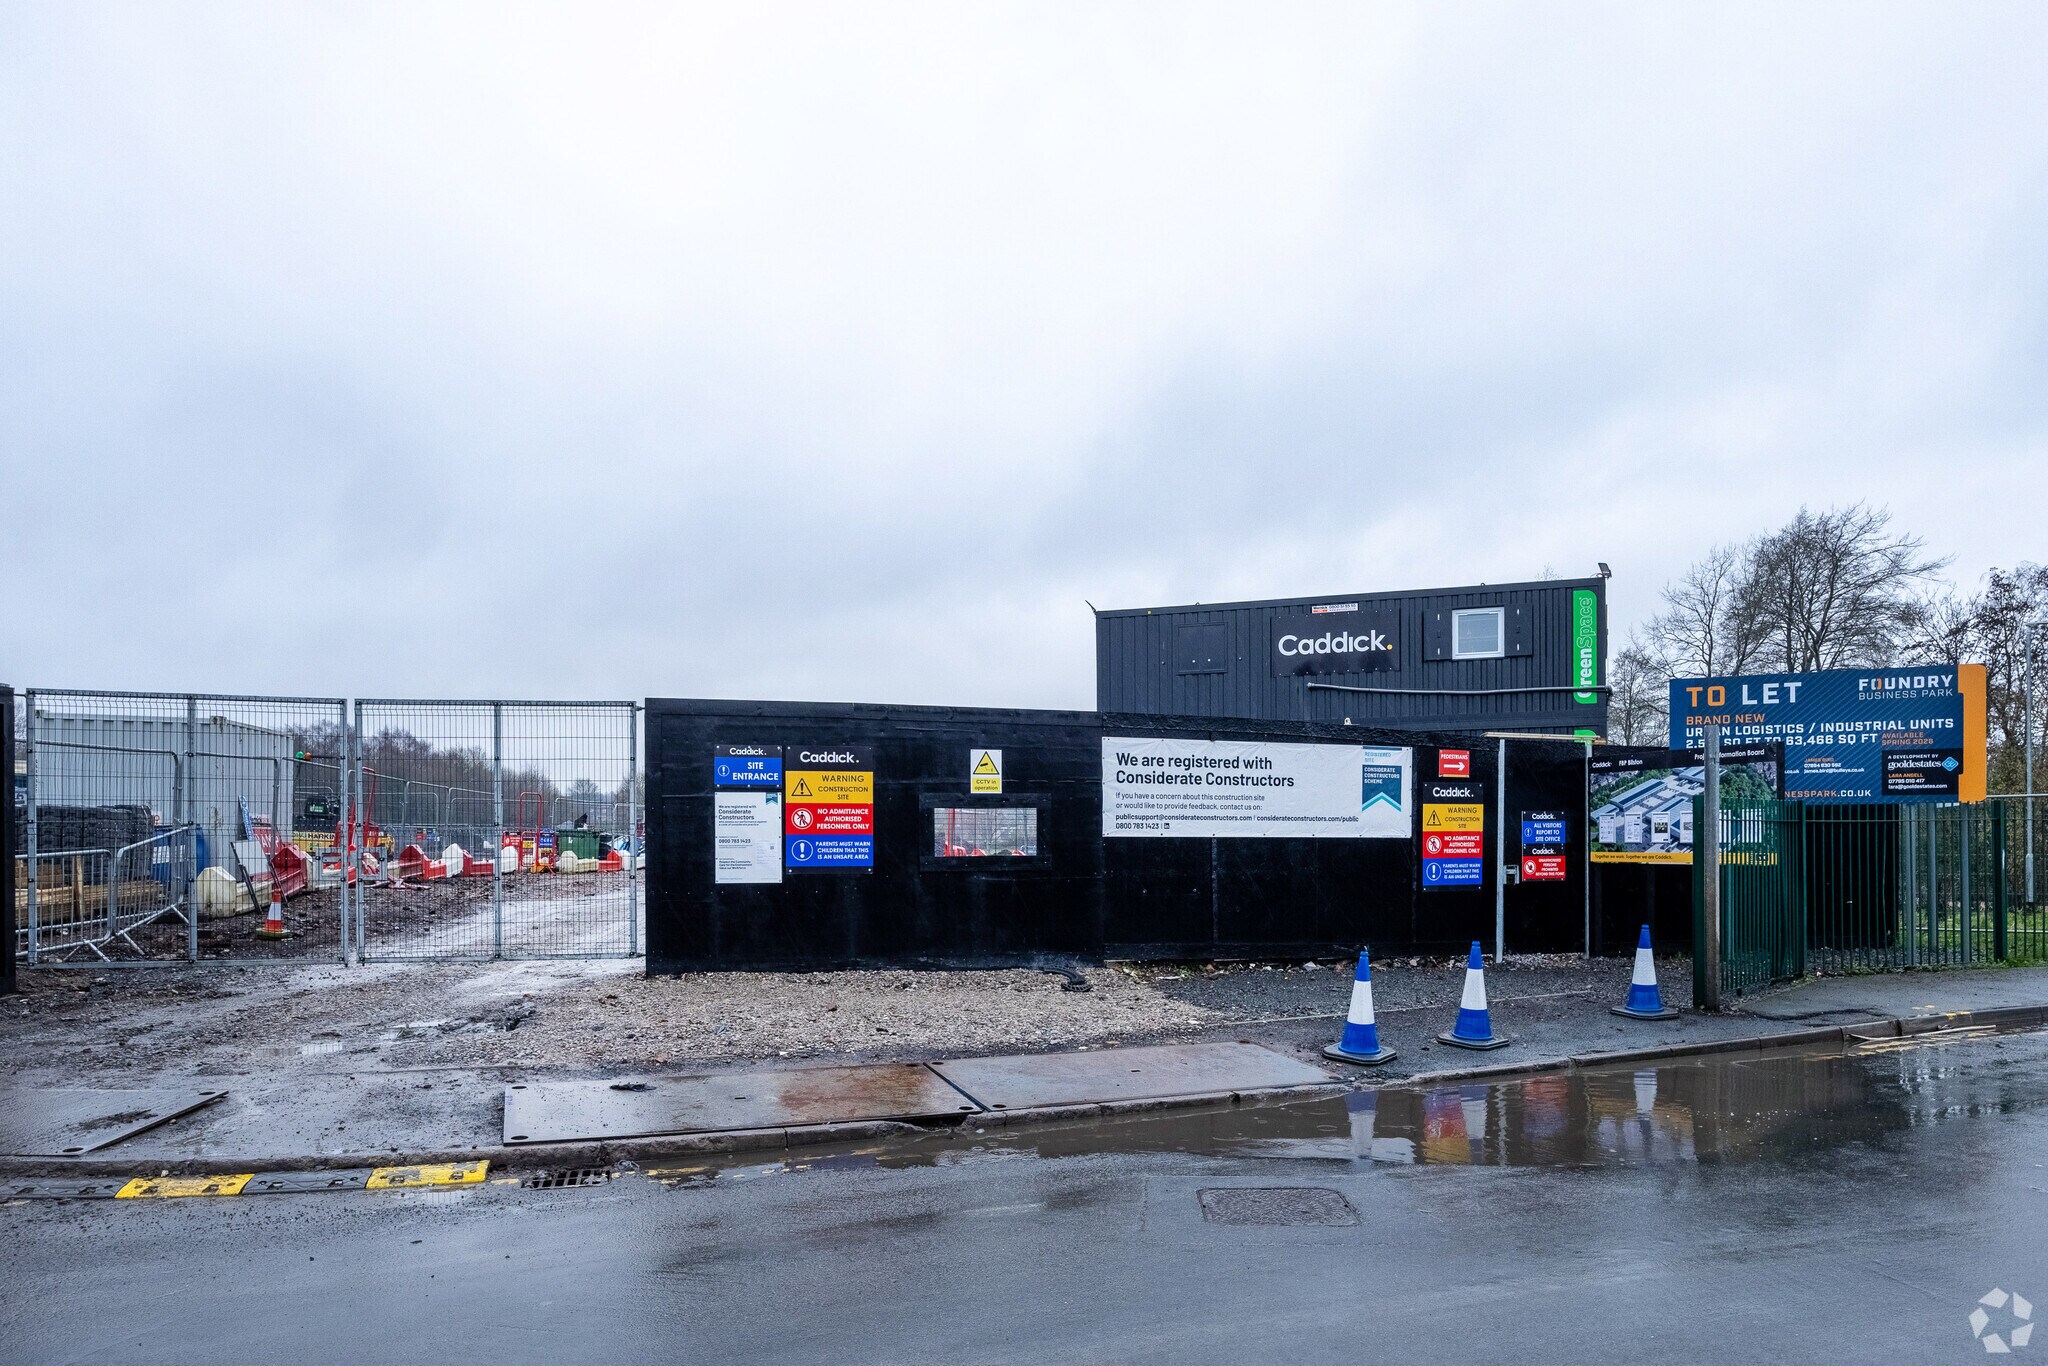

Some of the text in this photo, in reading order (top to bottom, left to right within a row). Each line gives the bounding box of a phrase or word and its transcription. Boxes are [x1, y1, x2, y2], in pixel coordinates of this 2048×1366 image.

[1859, 674, 1953, 691] FOUNDRY
[1686, 682, 1802, 707] TO LET
[1859, 688, 1953, 701] BUSINESS PARK
[1686, 713, 1765, 726] BRAND NEW
[1686, 718, 1954, 737] URN LOGISTICS / INDUSTRIAL UNITS
[1786, 735, 1834, 746] 63,466
[1838, 734, 1856, 745] SQ
[1861, 733, 1878, 743] FT
[1694, 753, 1705, 761] Proj
[1719, 750, 1746, 758] formation
[747, 762, 764, 770] SITE
[1116, 753, 1273, 771] We are registered with
[1888, 760, 1942, 771] gooldestates
[732, 772, 779, 781] ENTRANCE
[822, 775, 865, 783] WARNING
[1116, 770, 1295, 787] Considerate Constructors
[1214, 793, 1253, 801] construction
[1784, 789, 1871, 798] NESSPARK.CO.UK
[1219, 803, 1243, 811] contact
[1115, 813, 1359, 823] publicsupport@considerateconstructors.com considerateconstructors.com/public
